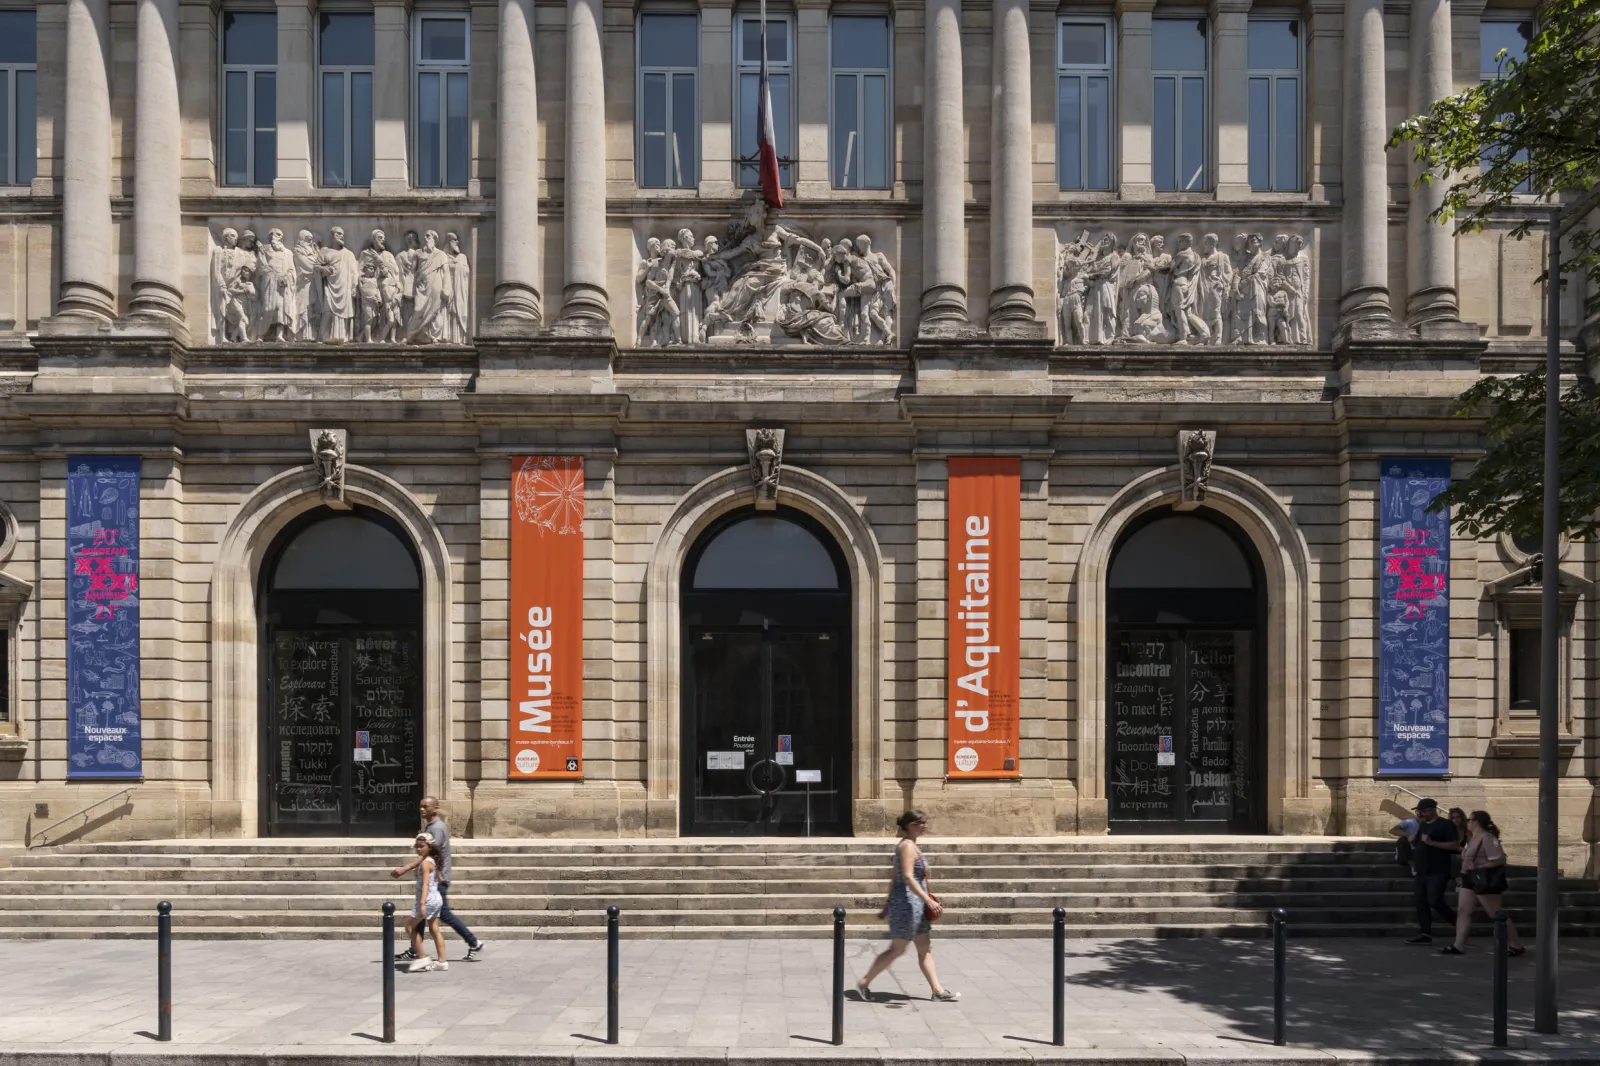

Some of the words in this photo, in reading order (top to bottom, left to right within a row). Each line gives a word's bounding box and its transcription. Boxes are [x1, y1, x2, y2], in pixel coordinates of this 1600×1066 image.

[81, 548, 128, 556] BORDEAUX
[1392, 548, 1438, 556] BORDEAUX
[75, 557, 115, 575] XX
[1386, 557, 1425, 574] XX
[84, 592, 129, 602] AQUITAINE
[356, 638, 397, 650] Rêver
[279, 657, 289, 669] To
[291, 657, 329, 674] explore
[329, 642, 339, 696] Erforschen
[519, 606, 552, 733] Musée
[1116, 661, 1171, 677] Encontrar
[1114, 682, 1154, 698] Ezagutu
[278, 694, 336, 723] 探索
[356, 705, 372, 717] To
[375, 705, 412, 717] dream
[1115, 700, 1129, 715] To
[1132, 702, 1156, 715] meet
[84, 725, 127, 734] Nouveaux
[279, 725, 341, 737] исследовать
[1116, 720, 1173, 736] Rencontrer
[1393, 723, 1435, 732] Nouveaux
[88, 734, 123, 744] espaces
[733, 734, 755, 742] Entrée
[1397, 732, 1431, 741] espaces
[1116, 740, 1160, 752] Incontra
[298, 757, 327, 769] Tukki
[296, 772, 333, 783] Explorer
[1190, 770, 1202, 786] To
[1203, 770, 1231, 786] share
[368, 778, 411, 794] Sonhar
[1130, 776, 1172, 797] 相遇
[356, 798, 416, 811] Träumen
[1120, 801, 1169, 811] встретить
